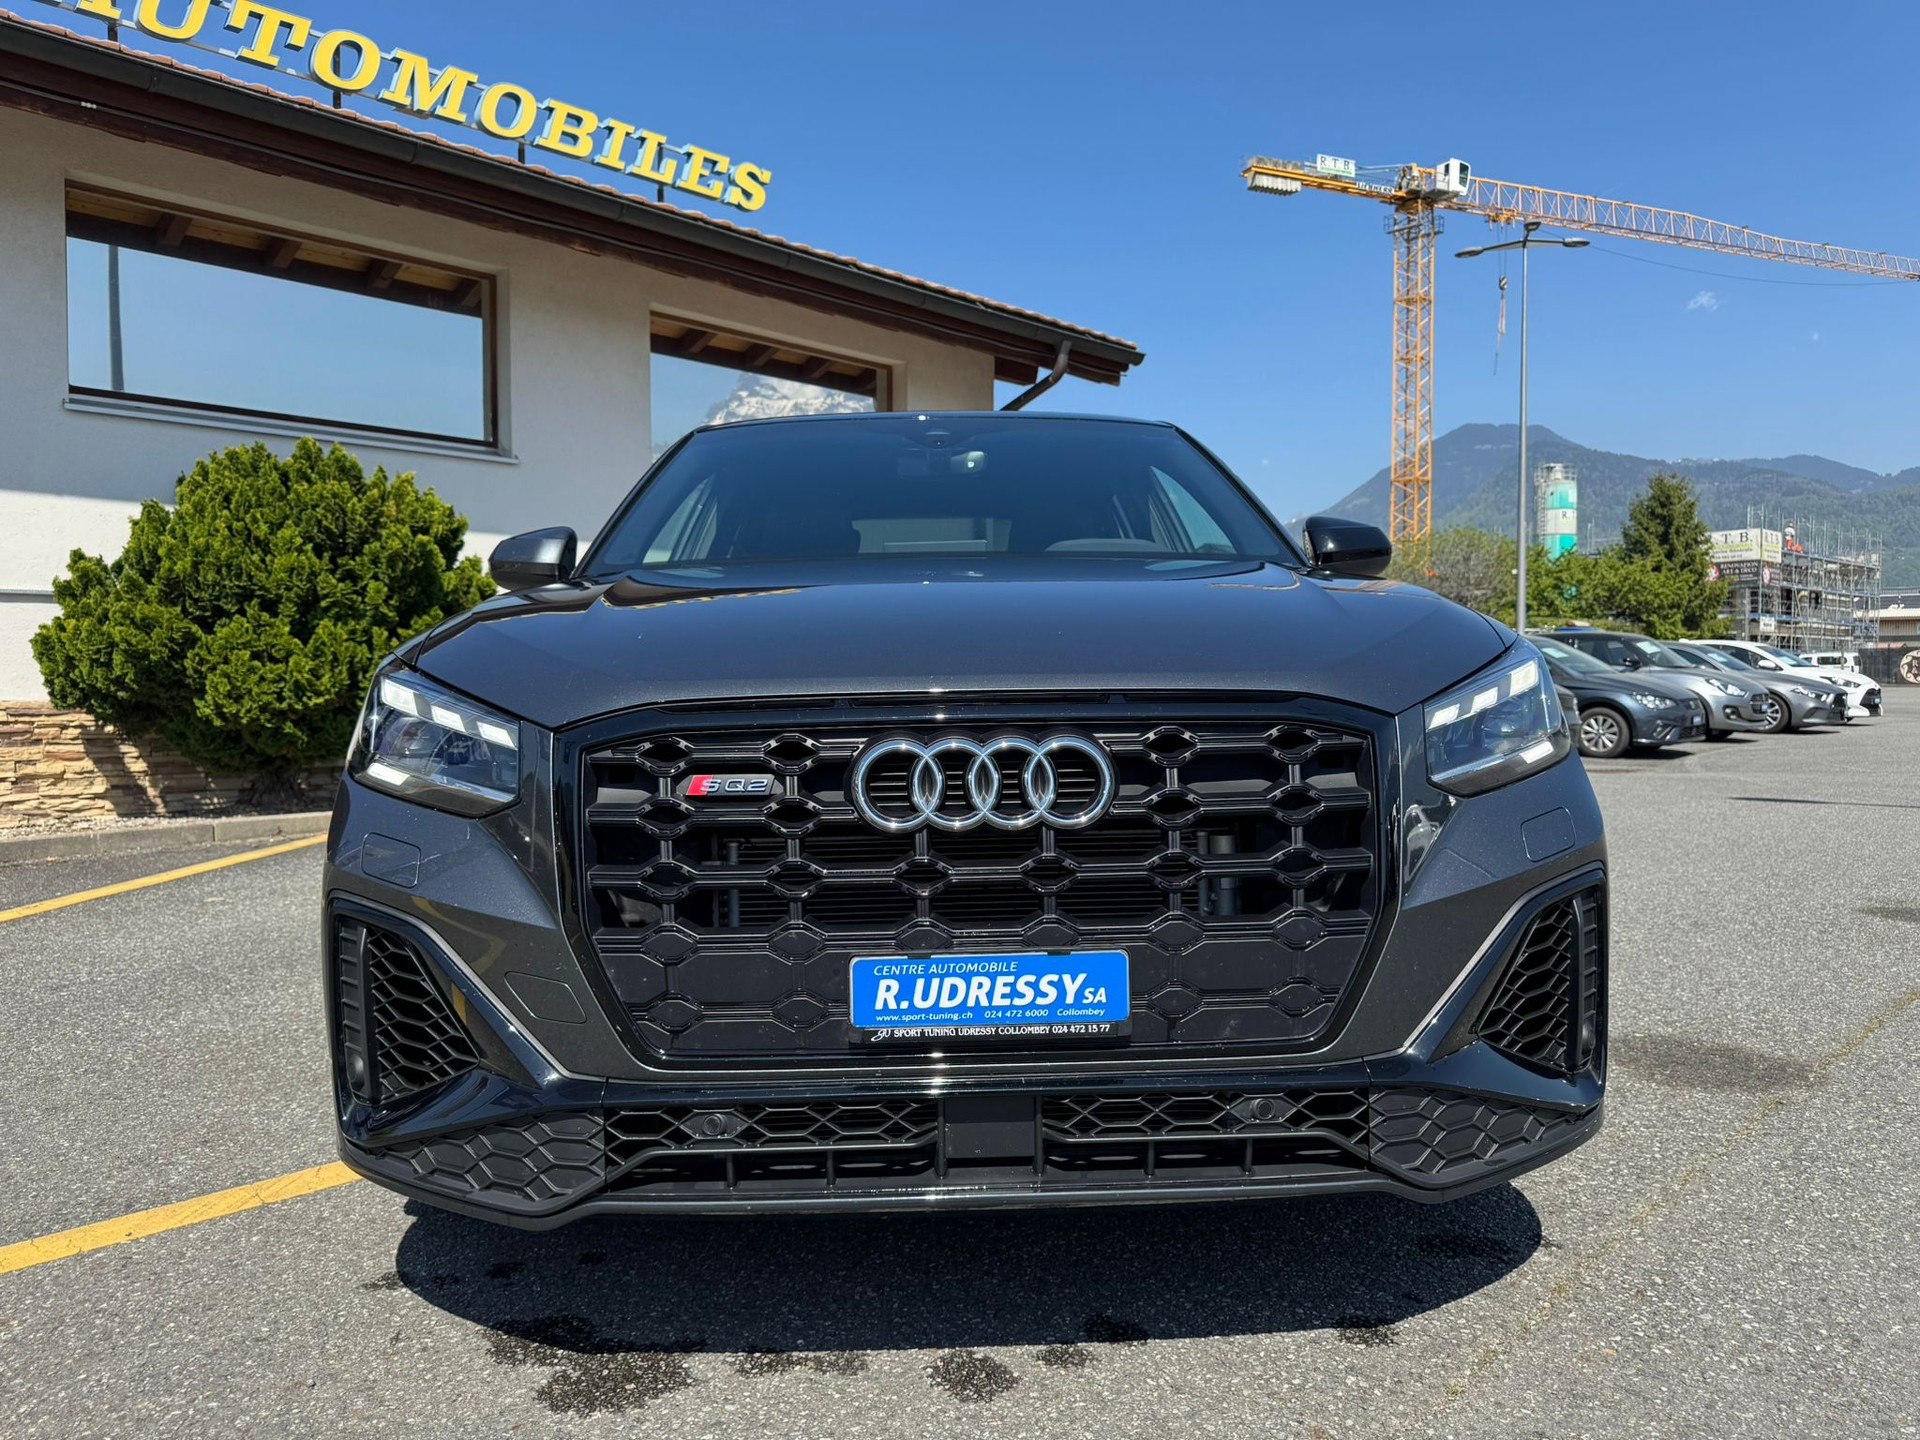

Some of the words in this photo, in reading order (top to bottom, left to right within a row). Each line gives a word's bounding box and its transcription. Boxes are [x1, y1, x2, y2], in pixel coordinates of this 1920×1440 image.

[75, 0, 772, 212] UTOMOBILES
[700, 778, 768, 792] SQ2
[873, 964, 926, 976] CENTRE
[928, 961, 1018, 975] AUTOMOBILE
[1082, 987, 1107, 1004] SA
[875, 1012, 973, 1022] www.sport-tuning.ch
[984, 1010, 1002, 1018] 024
[1005, 1009, 1022, 1017] 472
[1025, 1008, 1049, 1017] 6000
[1057, 1008, 1106, 1016] Collombey
[893, 1028, 922, 1038] SPORT
[923, 1027, 956, 1036] TUNING
[958, 1027, 996, 1035] UDRESSY
[998, 1026, 1050, 1034] COLLOMBEY
[1052, 1025, 1067, 1033] 024
[1069, 1025, 1086, 1033] 472
[1099, 1024, 1111, 1032] 77
